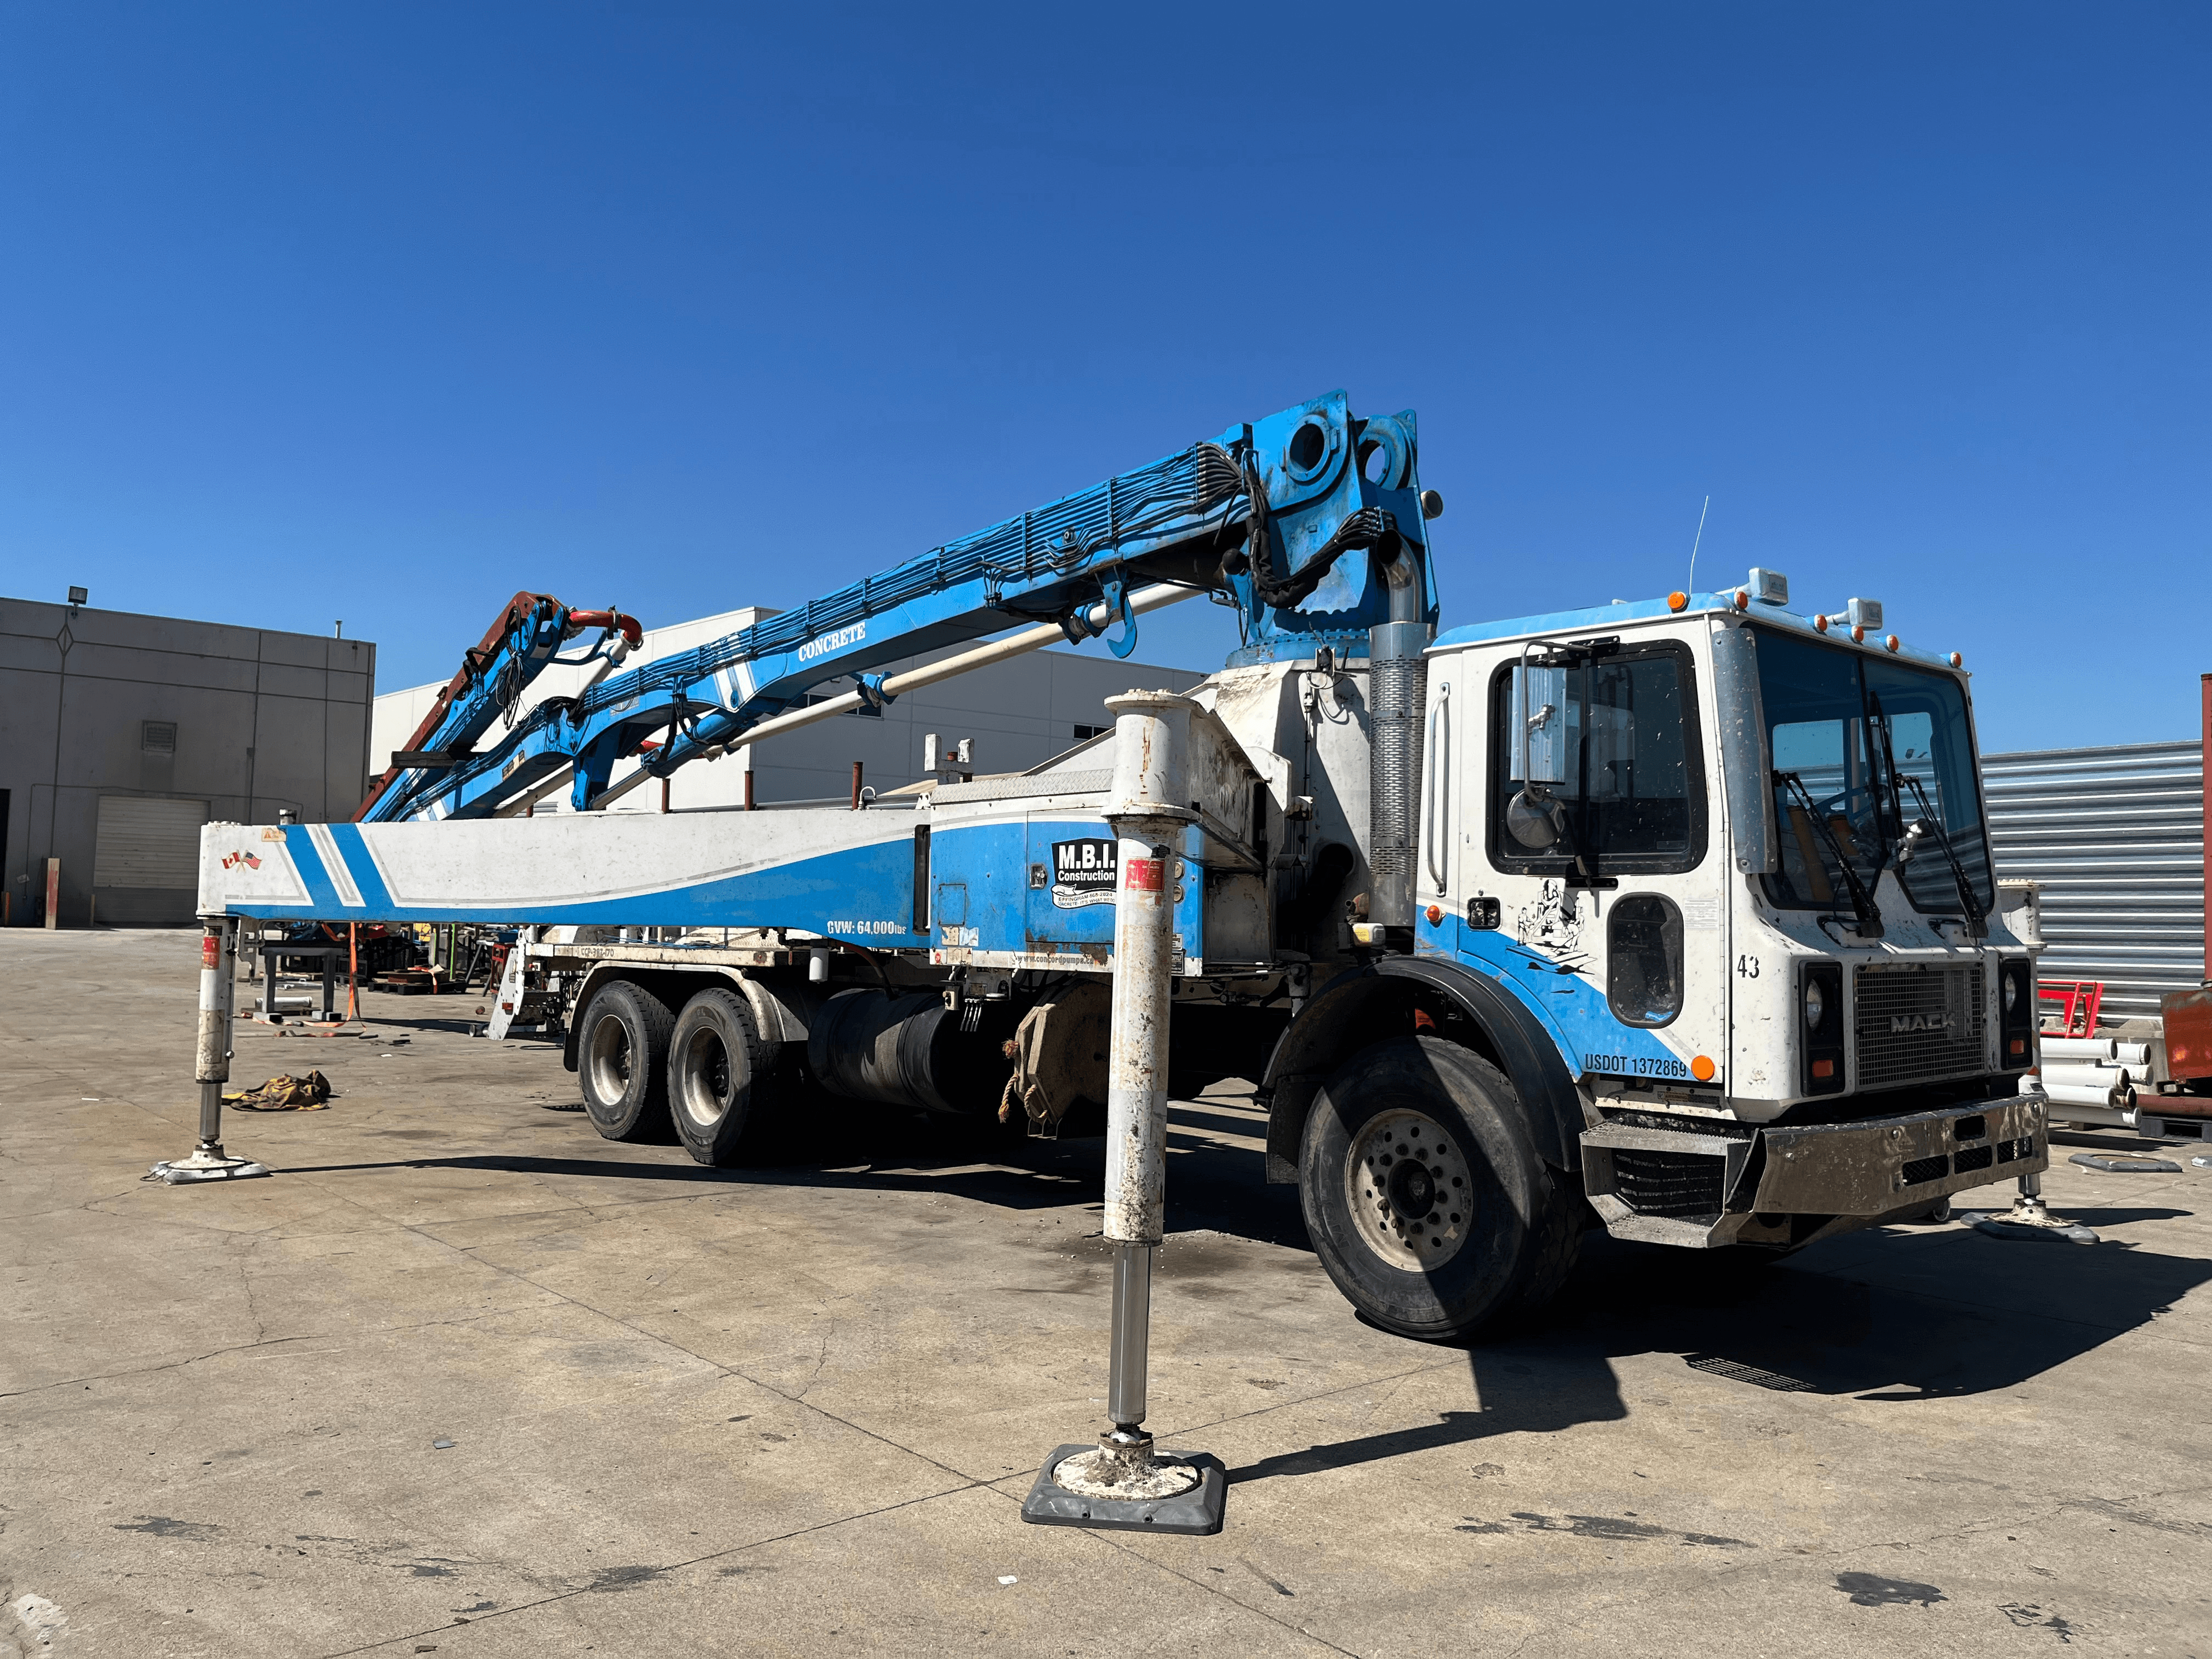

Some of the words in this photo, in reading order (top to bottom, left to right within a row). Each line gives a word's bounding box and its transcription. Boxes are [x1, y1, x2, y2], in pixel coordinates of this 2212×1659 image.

[798, 622, 866, 662] CONCRETE
[1059, 843, 1115, 869] M.B.I.
[1058, 869, 1115, 881] Construction
[827, 921, 855, 934] GVW:
[1017, 955, 1094, 965] www.concordpumps.ca
[1737, 954, 1760, 979] 43
[1891, 1013, 1957, 1033] MACK
[1585, 1054, 1627, 1073] USDOT
[1631, 1058, 1687, 1077] 1372869
